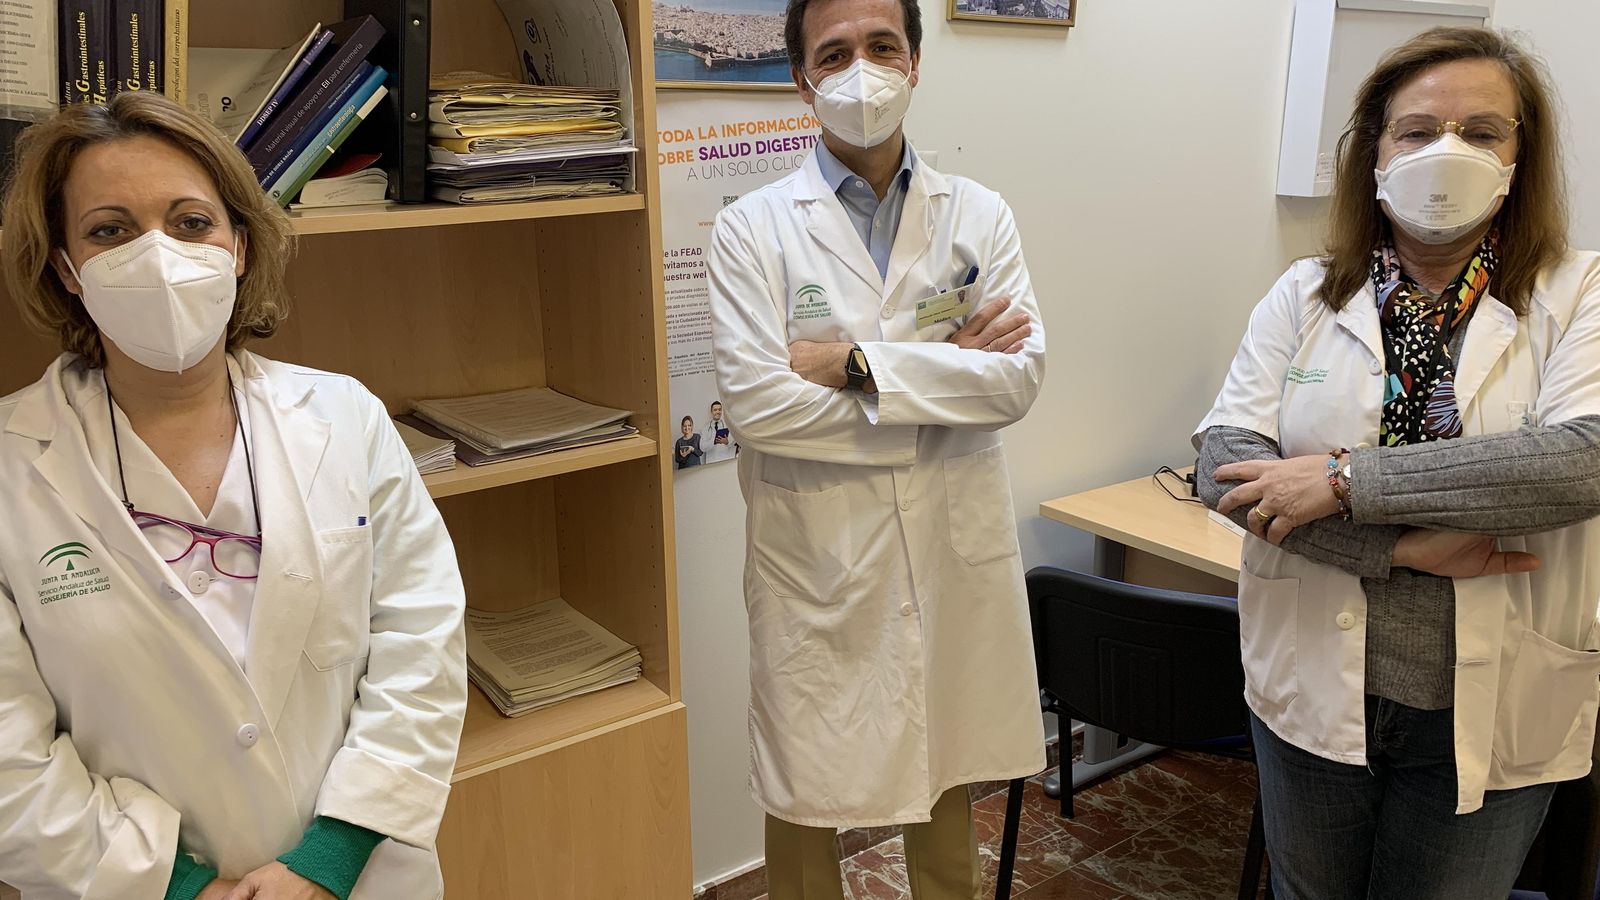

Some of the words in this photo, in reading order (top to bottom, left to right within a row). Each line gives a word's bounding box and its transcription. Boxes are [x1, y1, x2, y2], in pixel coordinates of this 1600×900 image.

[76, 11, 90, 92] Gastrointestinales
[127, 13, 140, 91] Gastrointestinales
[94, 61, 107, 104] Hepáticas
[148, 61, 157, 92] epáticas
[265, 130, 286, 153] Material
[282, 114, 299, 132] visual
[295, 107, 306, 118] de
[302, 92, 319, 111] apoyo
[315, 86, 325, 95] en
[327, 68, 341, 82] para
[337, 42, 363, 70] enfermería
[255, 104, 275, 126] DDSEP
[270, 98, 279, 108] IV
[656, 129, 694, 145] TODA
[698, 126, 718, 140] LA
[722, 113, 822, 138] INFORMACIÓN
[658, 150, 694, 165] OBRE
[699, 142, 751, 161] SALUD
[756, 135, 822, 154] DIGESTIV
[687, 168, 698, 181] A
[702, 164, 724, 180] UN
[728, 159, 769, 177] SOLO
[1429, 194, 1448, 202] 3M
[664, 260, 697, 270] nvitamos
[681, 248, 702, 256] FEAD
[38, 587, 58, 597] Servicio
[59, 582, 84, 592] Andaluz
[94, 576, 109, 584] Salud
[41, 576, 58, 585] JUNTA
[90, 584, 111, 593] SALUD
